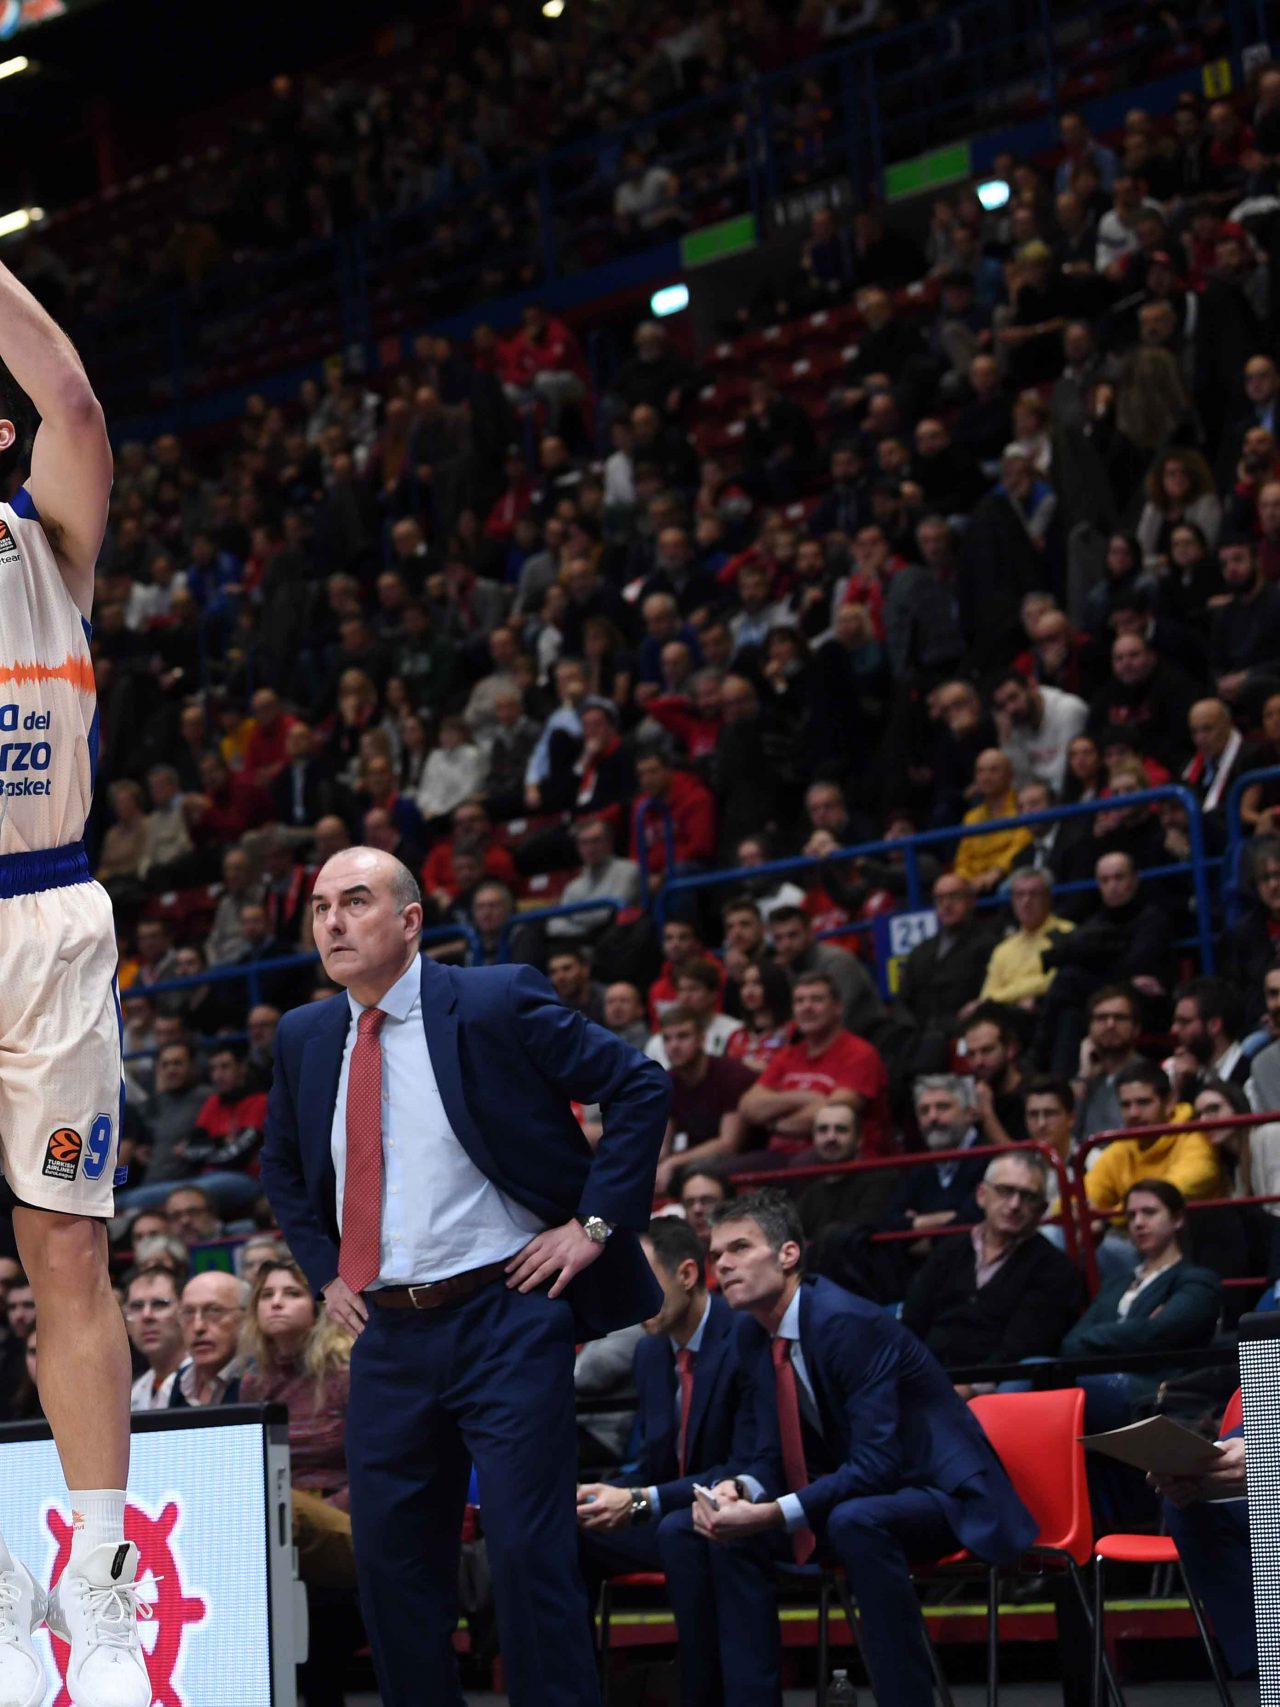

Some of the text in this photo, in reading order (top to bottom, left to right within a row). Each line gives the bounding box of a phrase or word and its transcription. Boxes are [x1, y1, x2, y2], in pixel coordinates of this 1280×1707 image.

[23, 710, 51, 731] del
[82, 1112, 113, 1181] 9
[46, 1164, 75, 1174] AIRLINES
[47, 1159, 76, 1168] TURKISH
